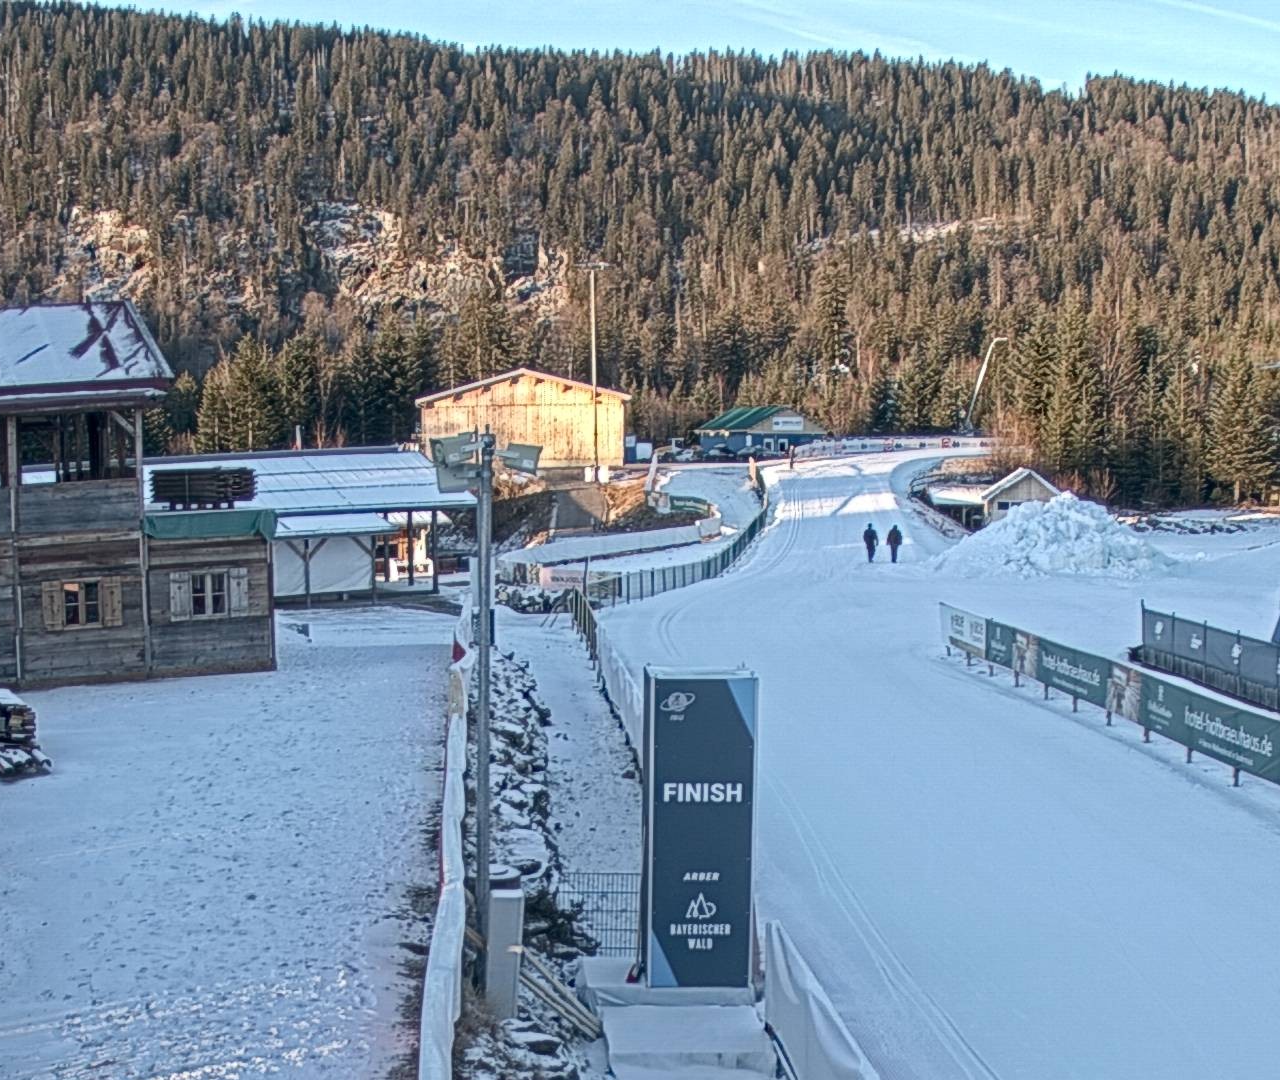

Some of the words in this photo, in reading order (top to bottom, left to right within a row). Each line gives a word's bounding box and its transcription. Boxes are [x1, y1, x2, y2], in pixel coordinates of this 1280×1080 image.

[663, 782, 742, 803] FINISH
[670, 923, 732, 936] BAYERISCHER
[687, 938, 714, 950] WALD
